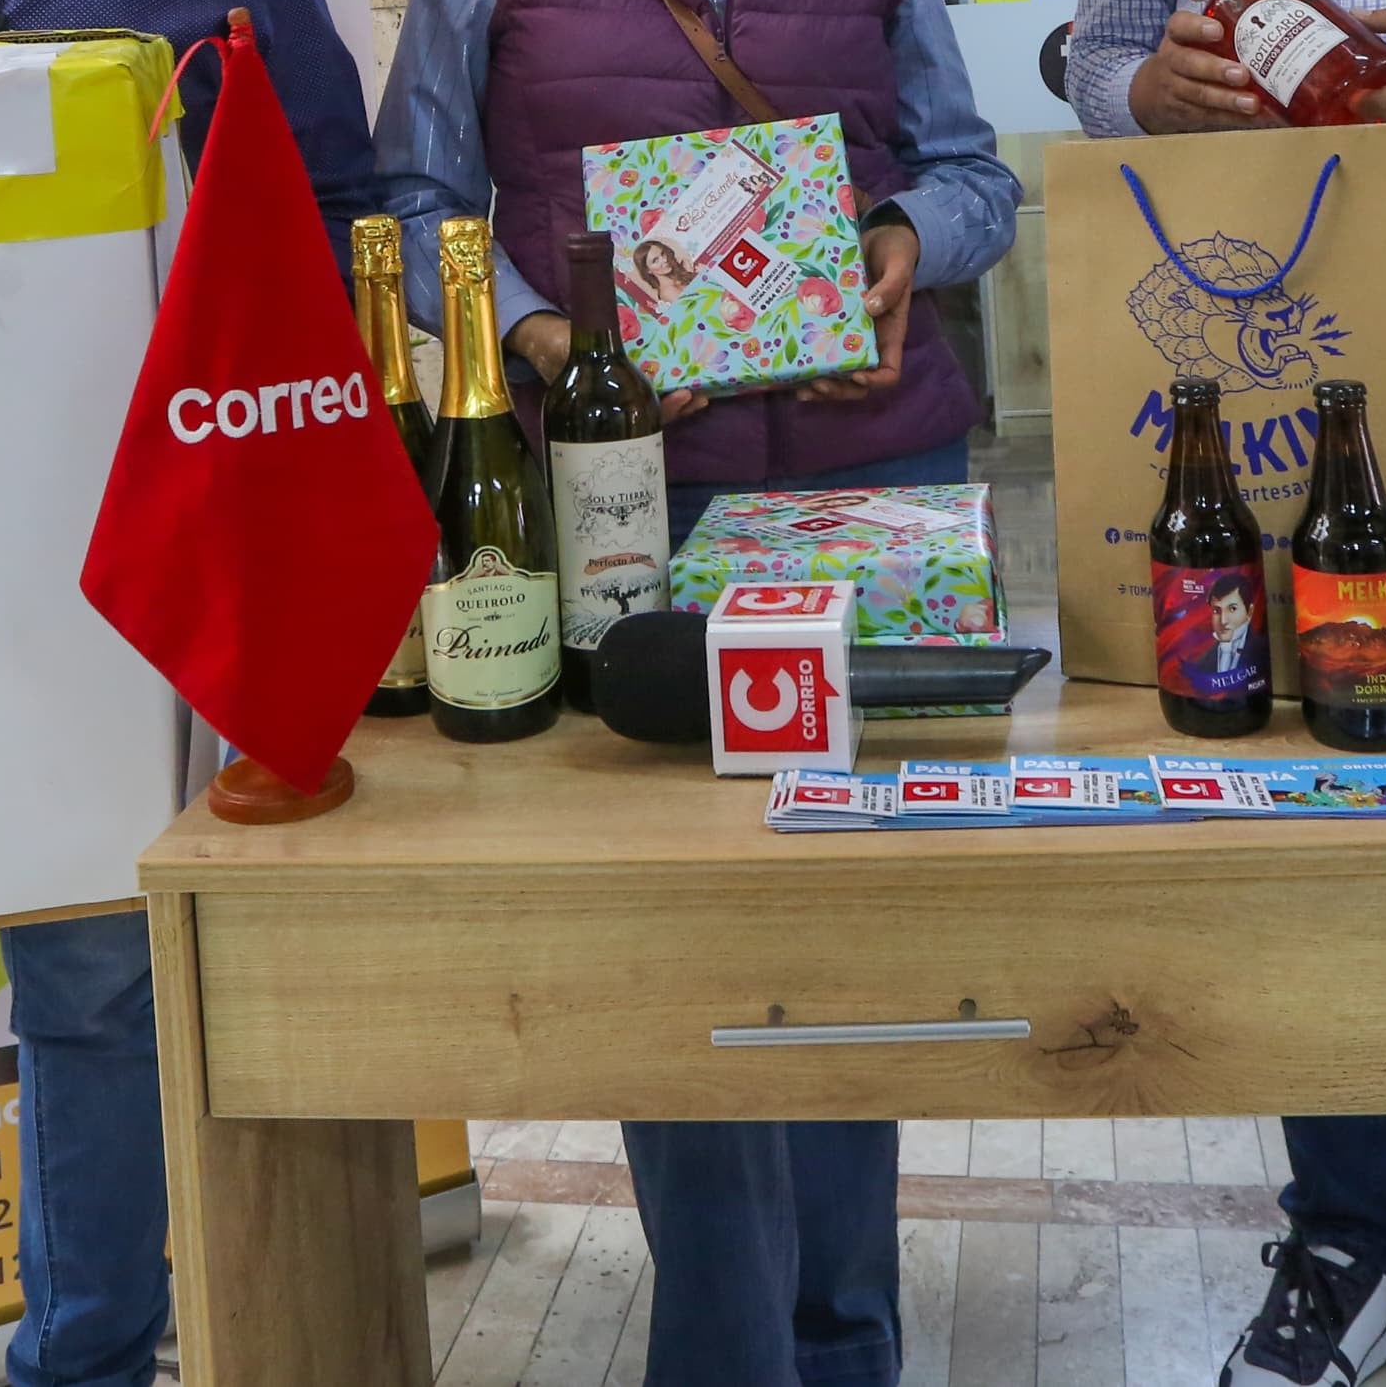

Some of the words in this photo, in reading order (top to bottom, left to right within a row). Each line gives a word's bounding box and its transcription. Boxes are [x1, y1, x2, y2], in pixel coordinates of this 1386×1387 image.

[1261, 48, 1281, 77] FRUTOS
[1280, 25, 1303, 50] ROJOS
[587, 495, 607, 504] SOL
[619, 490, 650, 502] TIERRA
[1241, 479, 1312, 502] artesa
[467, 583, 513, 595] SANTIAGO
[456, 593, 526, 612] QUEIROLO
[433, 616, 551, 661] Primado
[1210, 665, 1257, 689] MELGAR
[798, 659, 817, 741] CORREO
[915, 764, 972, 775] PASE
[1024, 760, 1081, 771] PASE
[1165, 759, 1223, 771] PASE
